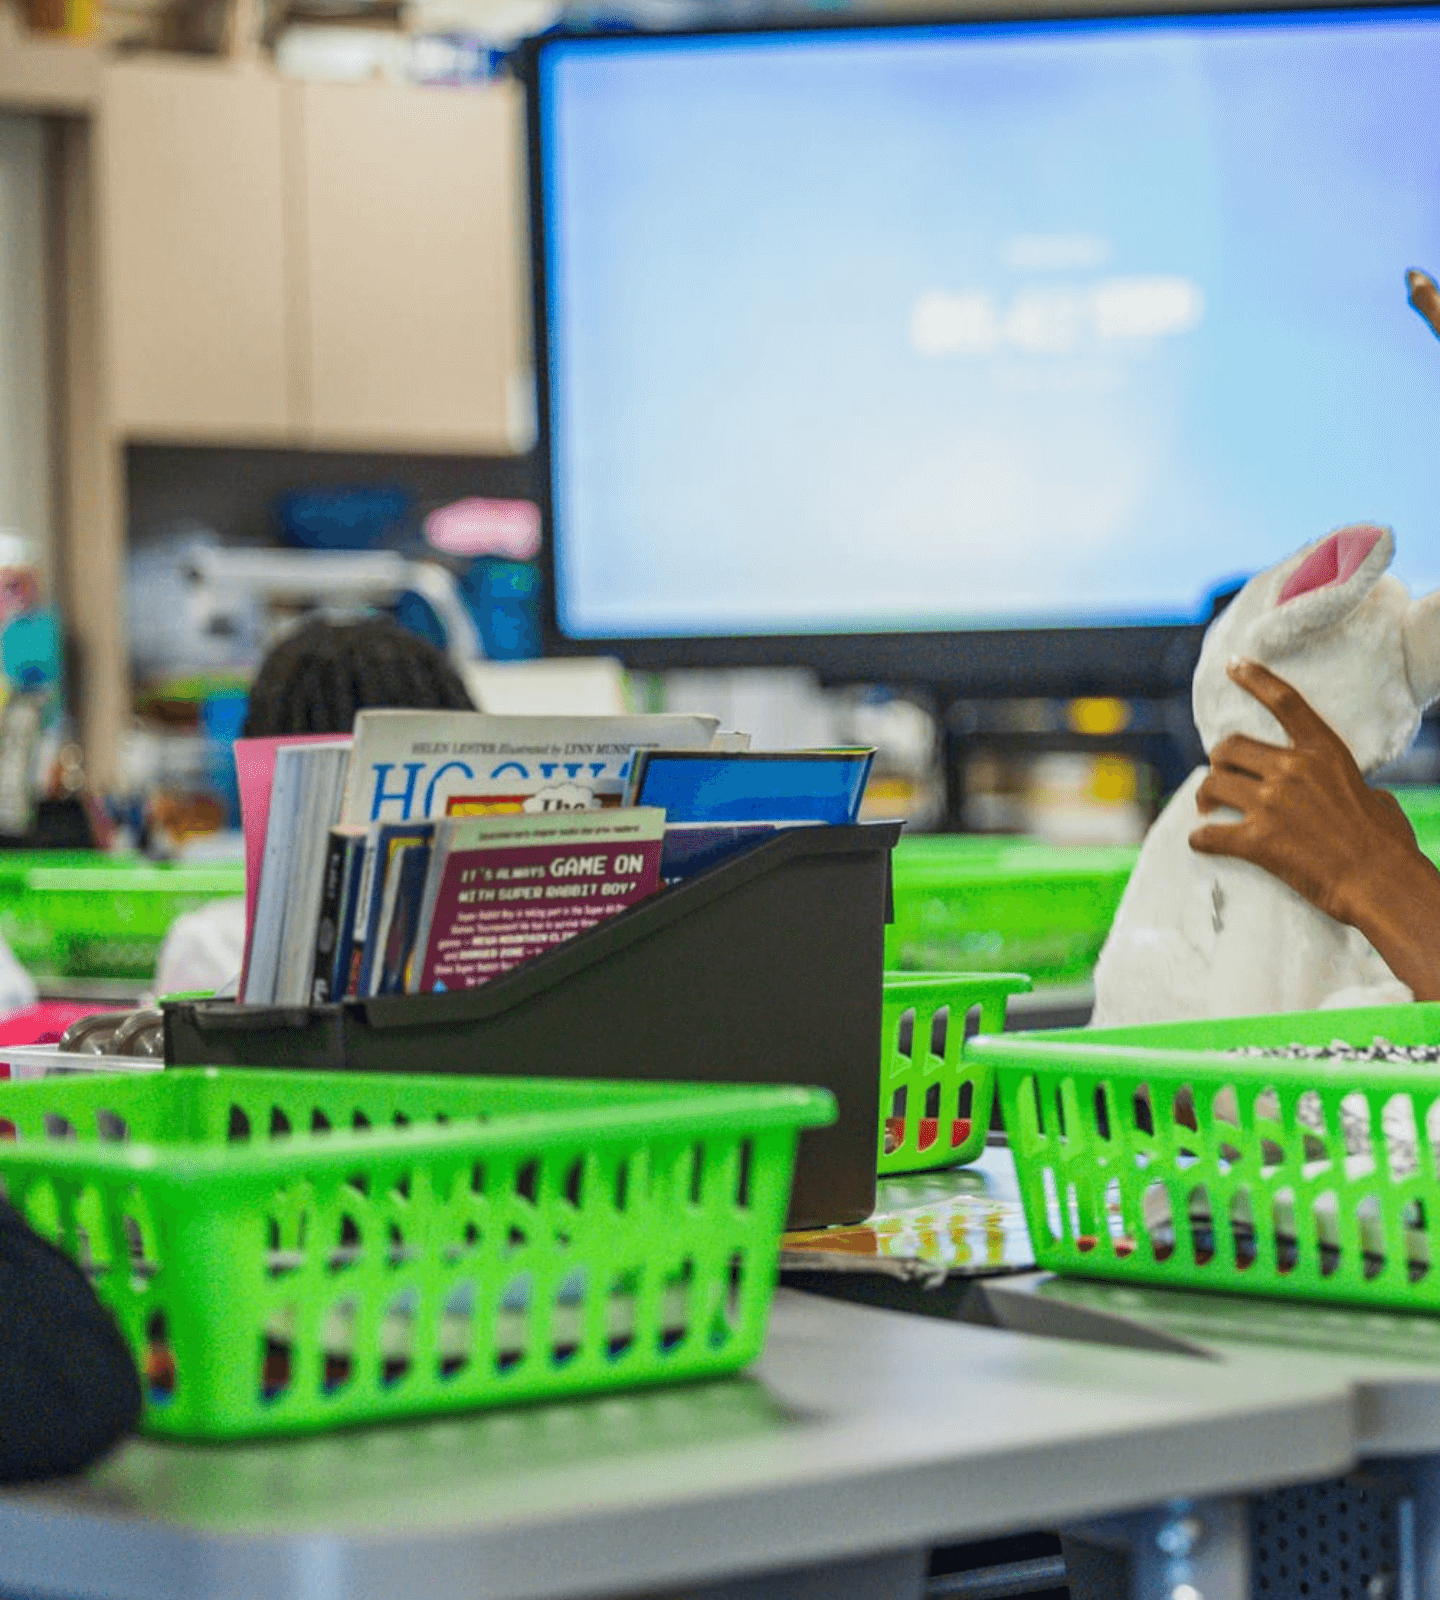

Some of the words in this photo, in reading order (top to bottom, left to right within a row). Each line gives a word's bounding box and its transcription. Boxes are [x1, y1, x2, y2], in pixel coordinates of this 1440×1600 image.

[496, 866, 546, 881] ALWAYS
[549, 855, 608, 878] GAME
[614, 854, 645, 875] ON
[458, 888, 495, 903] WITH
[498, 886, 543, 900] SUPER
[545, 883, 598, 898] RABBIT
